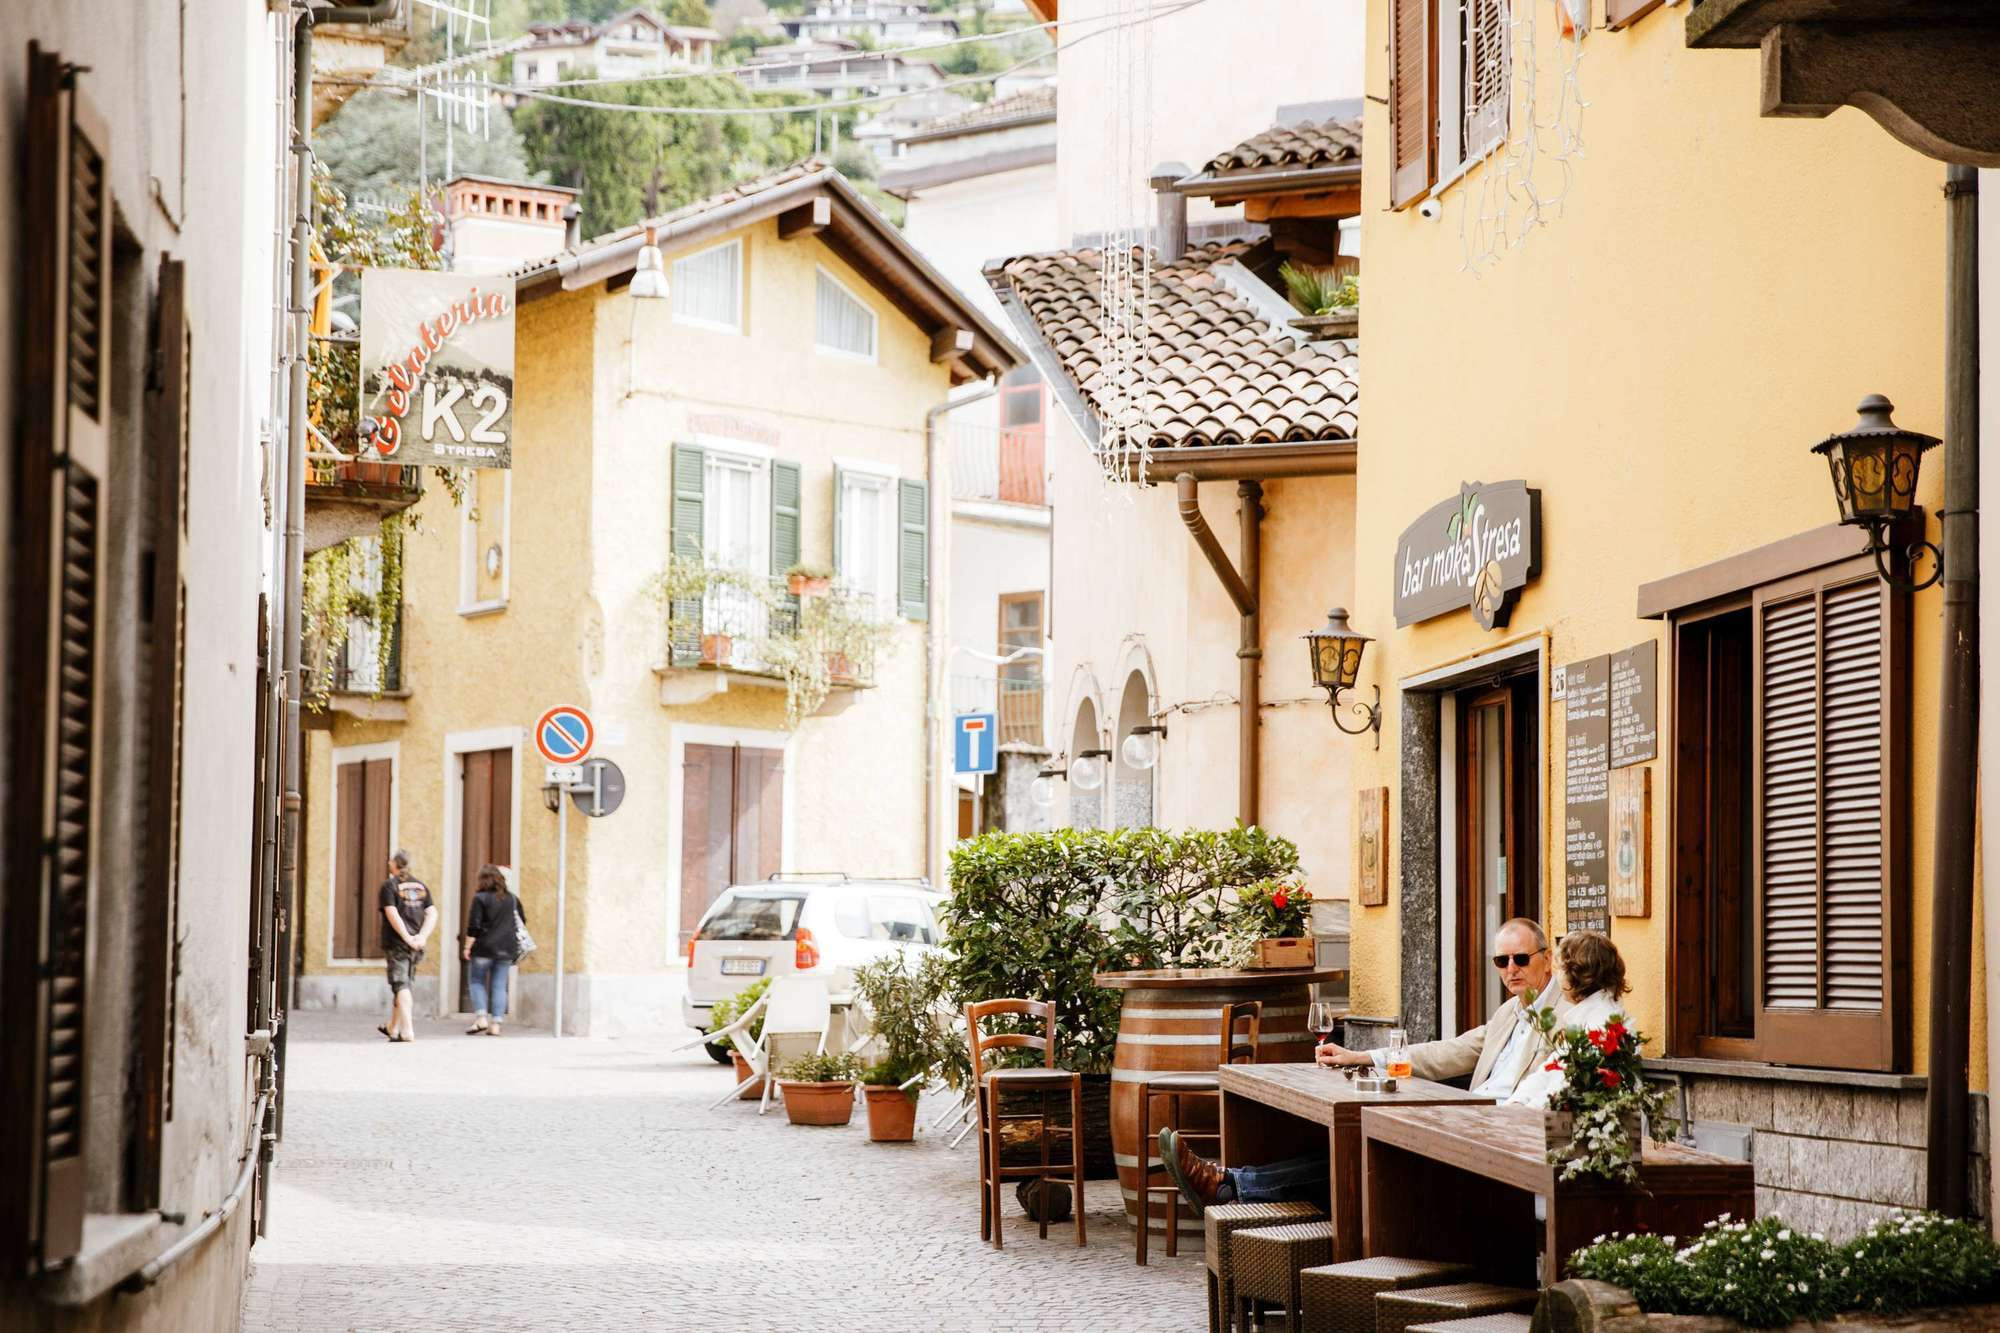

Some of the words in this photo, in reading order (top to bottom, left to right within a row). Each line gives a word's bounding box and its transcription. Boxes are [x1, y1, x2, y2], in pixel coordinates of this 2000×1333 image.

[421, 382, 508, 444] K2
[1401, 544, 1430, 599] bar
[1555, 673, 1565, 693] 26
